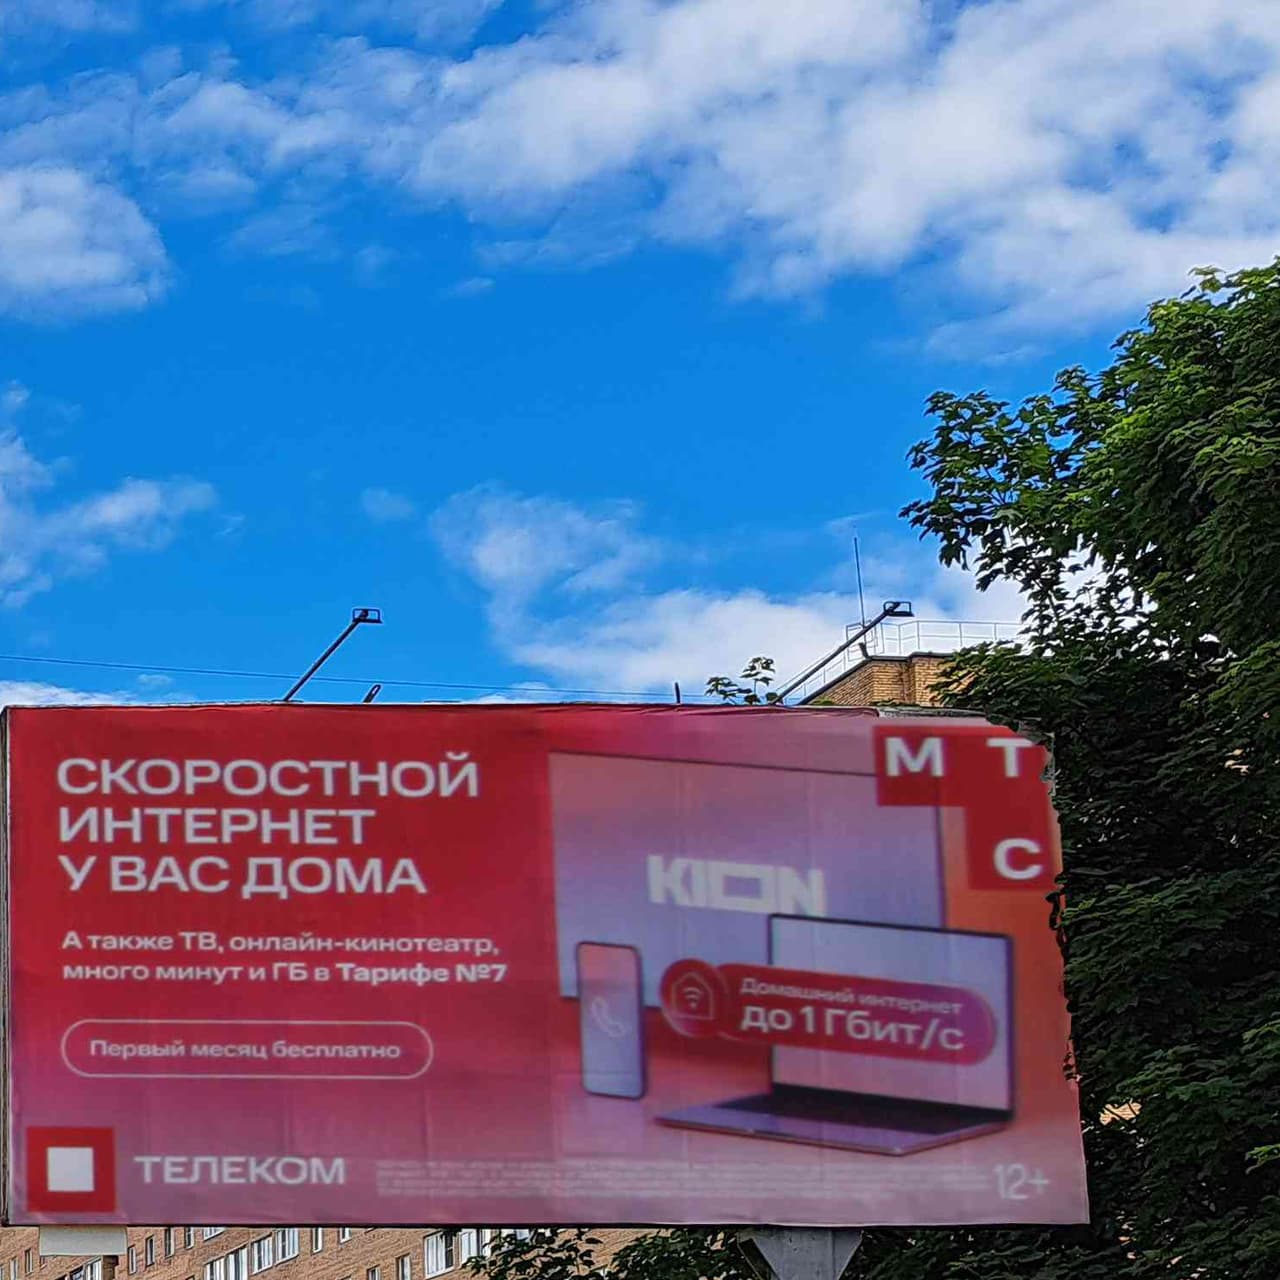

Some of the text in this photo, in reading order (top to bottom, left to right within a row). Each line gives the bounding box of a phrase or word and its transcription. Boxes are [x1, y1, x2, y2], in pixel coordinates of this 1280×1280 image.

[56, 751, 480, 798] СКОРОСТНОЙ
[58, 806, 376, 845] ИНТЕРНЕТ
[58, 855, 428, 900] У ВАС ДОМА
[645, 854, 828, 918] KION
[62, 931, 500, 956] А также ТВ, онлайн-кинотеатр,
[62, 962, 508, 986] много минут и ГБ в Тарифе №7
[741, 977, 964, 1015] Домашний интернет
[740, 1005, 965, 1051] до 1 Гбит/с
[89, 1039, 401, 1061] Первый месяц бесплатно
[134, 1155, 346, 1186] ТЕЛЕКОМ
[994, 1163, 1051, 1201] 12+
